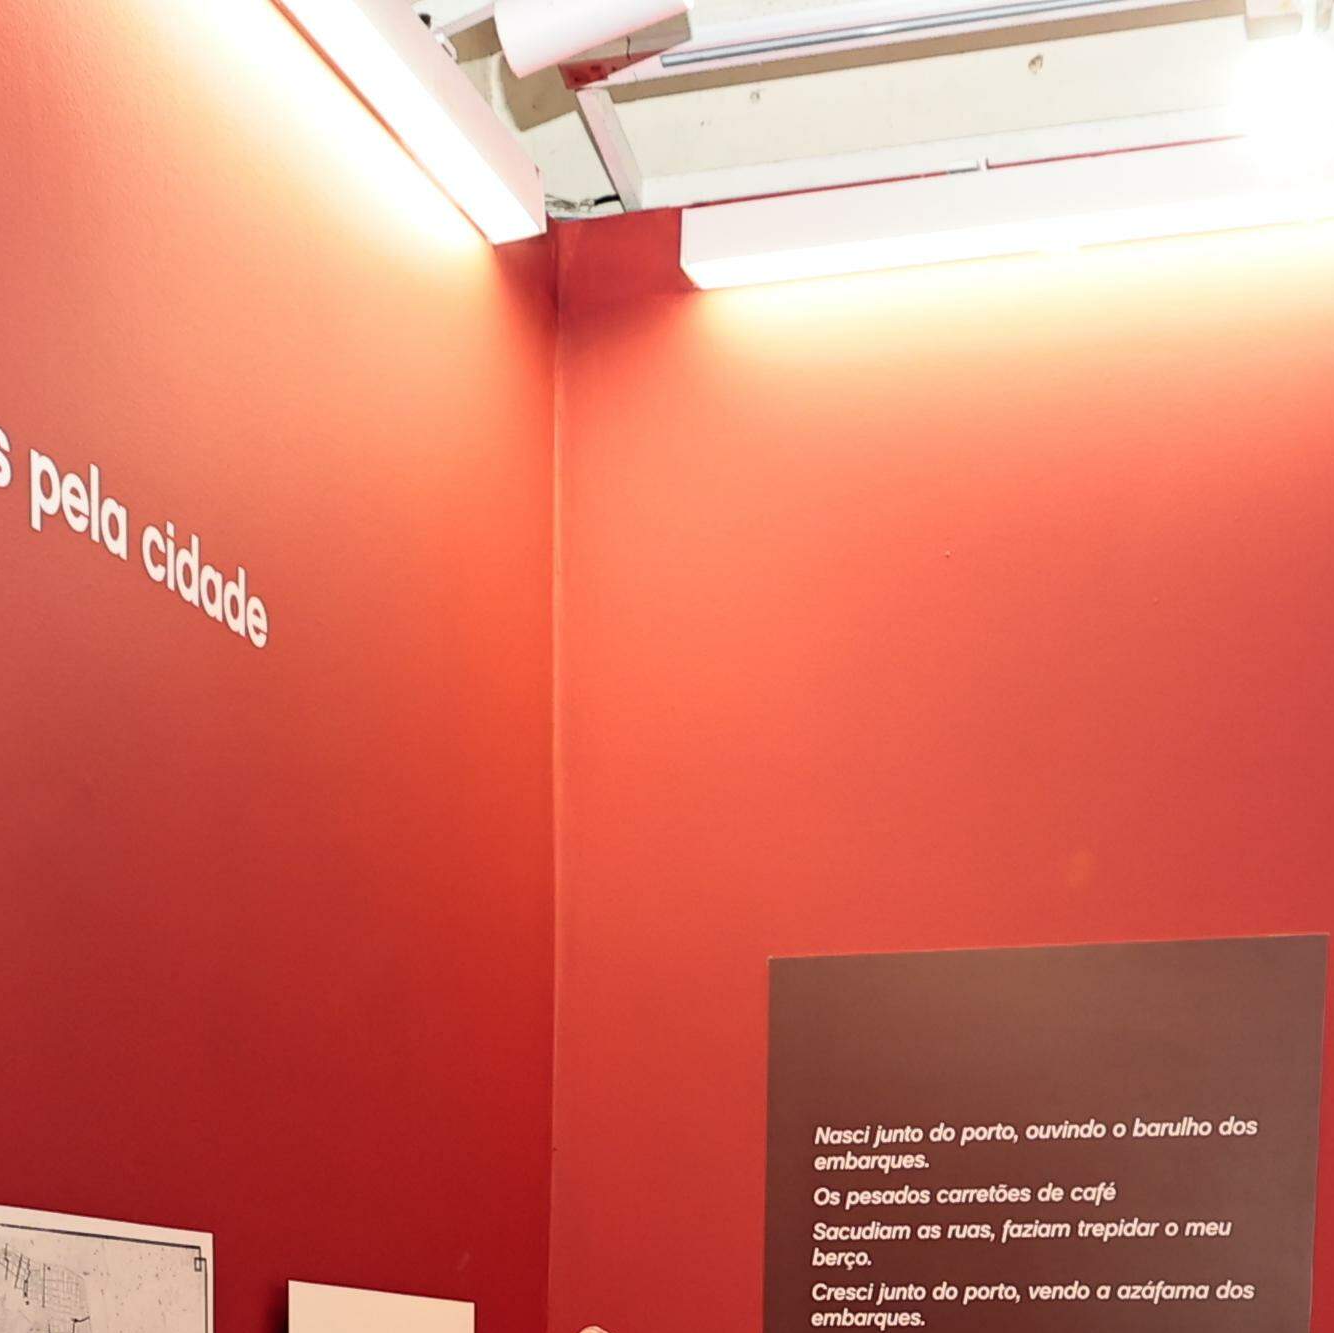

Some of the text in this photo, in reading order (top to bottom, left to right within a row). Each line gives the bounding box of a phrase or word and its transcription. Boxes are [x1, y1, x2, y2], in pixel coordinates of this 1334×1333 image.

[30, 449, 127, 560] pela
[142, 523, 267, 646] cidade
[814, 1116, 1258, 1148] Nasci junto do porto, ouvindo o barulho dos
[814, 1151, 929, 1174] embarques.
[813, 1182, 1116, 1210] Os pesados carretões de café
[812, 1217, 1232, 1243] Sacudiam as ruas, faziam trepidar o meu
[812, 1247, 872, 1271] berço.
[812, 1280, 1255, 1306] Cresci junto do porto, vendo a azáfama dos
[811, 1308, 925, 1331] embarques.
